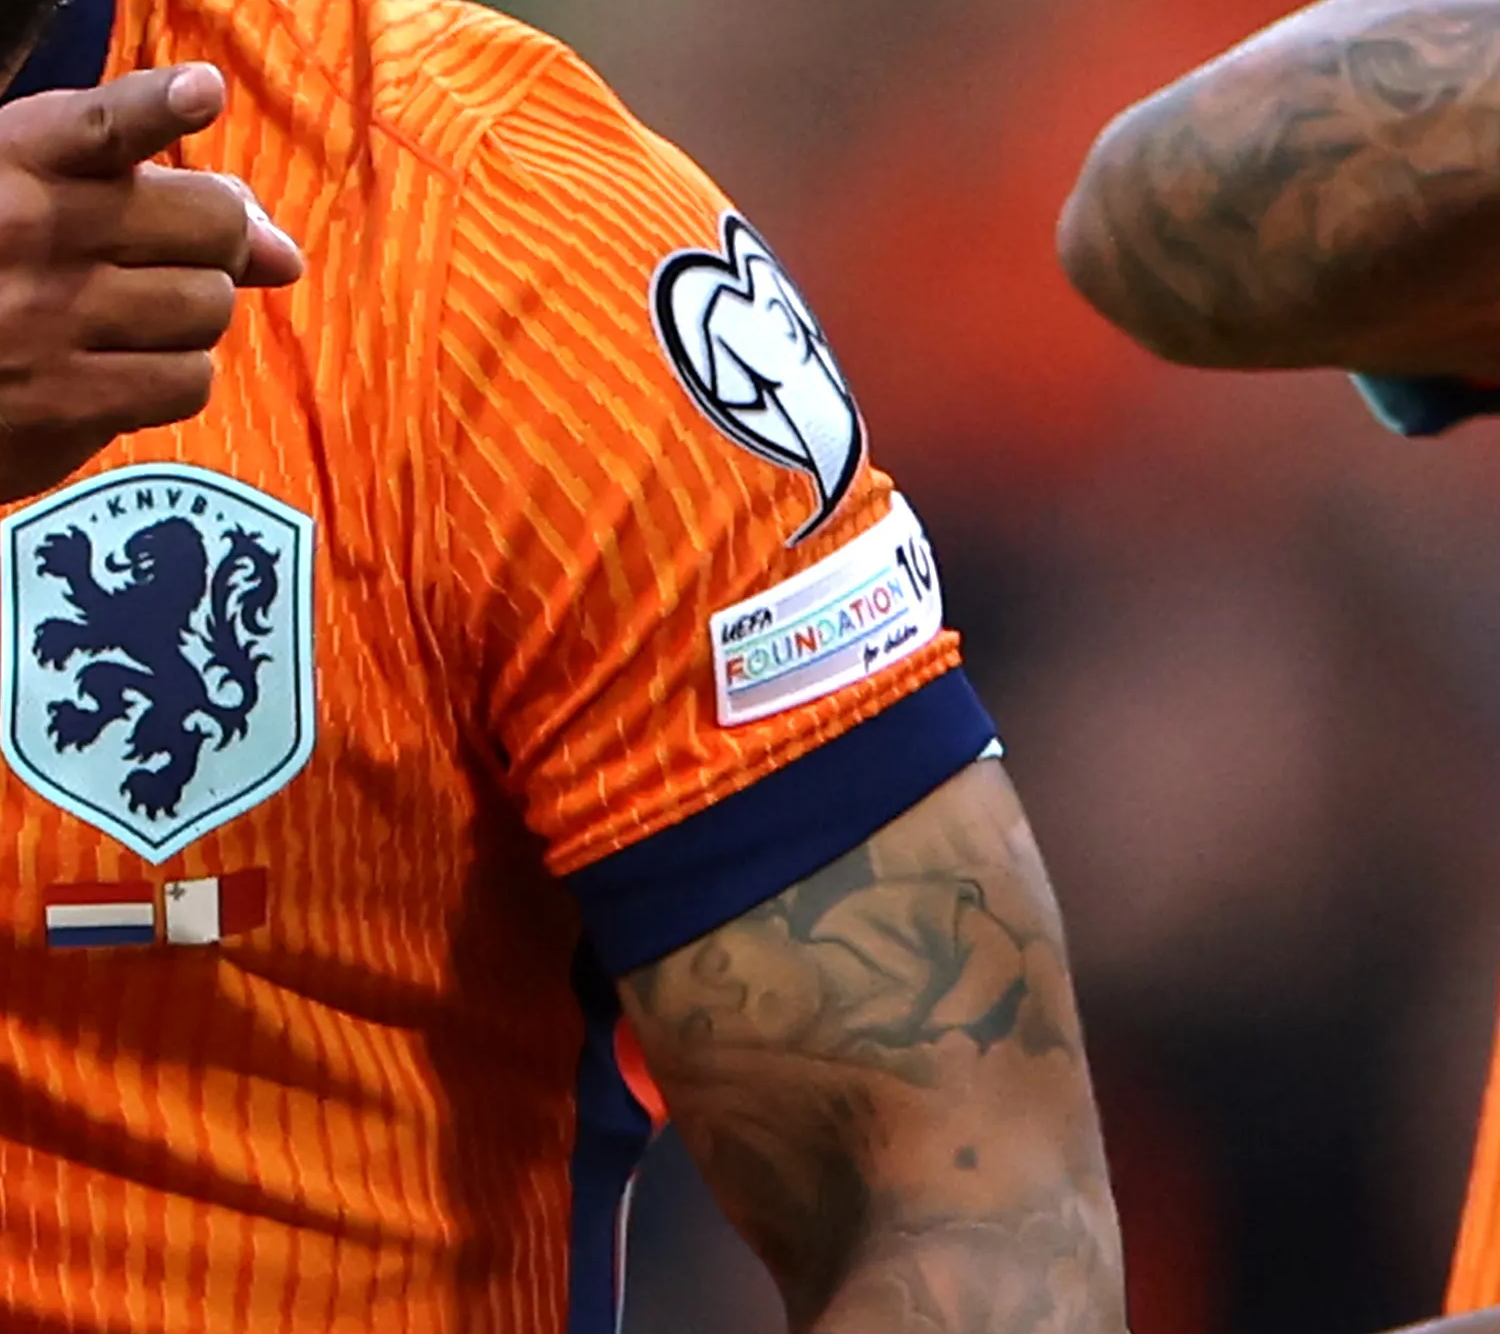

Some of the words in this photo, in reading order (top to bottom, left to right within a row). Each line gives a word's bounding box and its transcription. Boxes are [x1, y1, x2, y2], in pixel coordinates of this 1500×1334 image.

[106, 487, 208, 519] KNVB
[722, 608, 772, 645] UEFA
[726, 577, 904, 685] FOUNDATION
